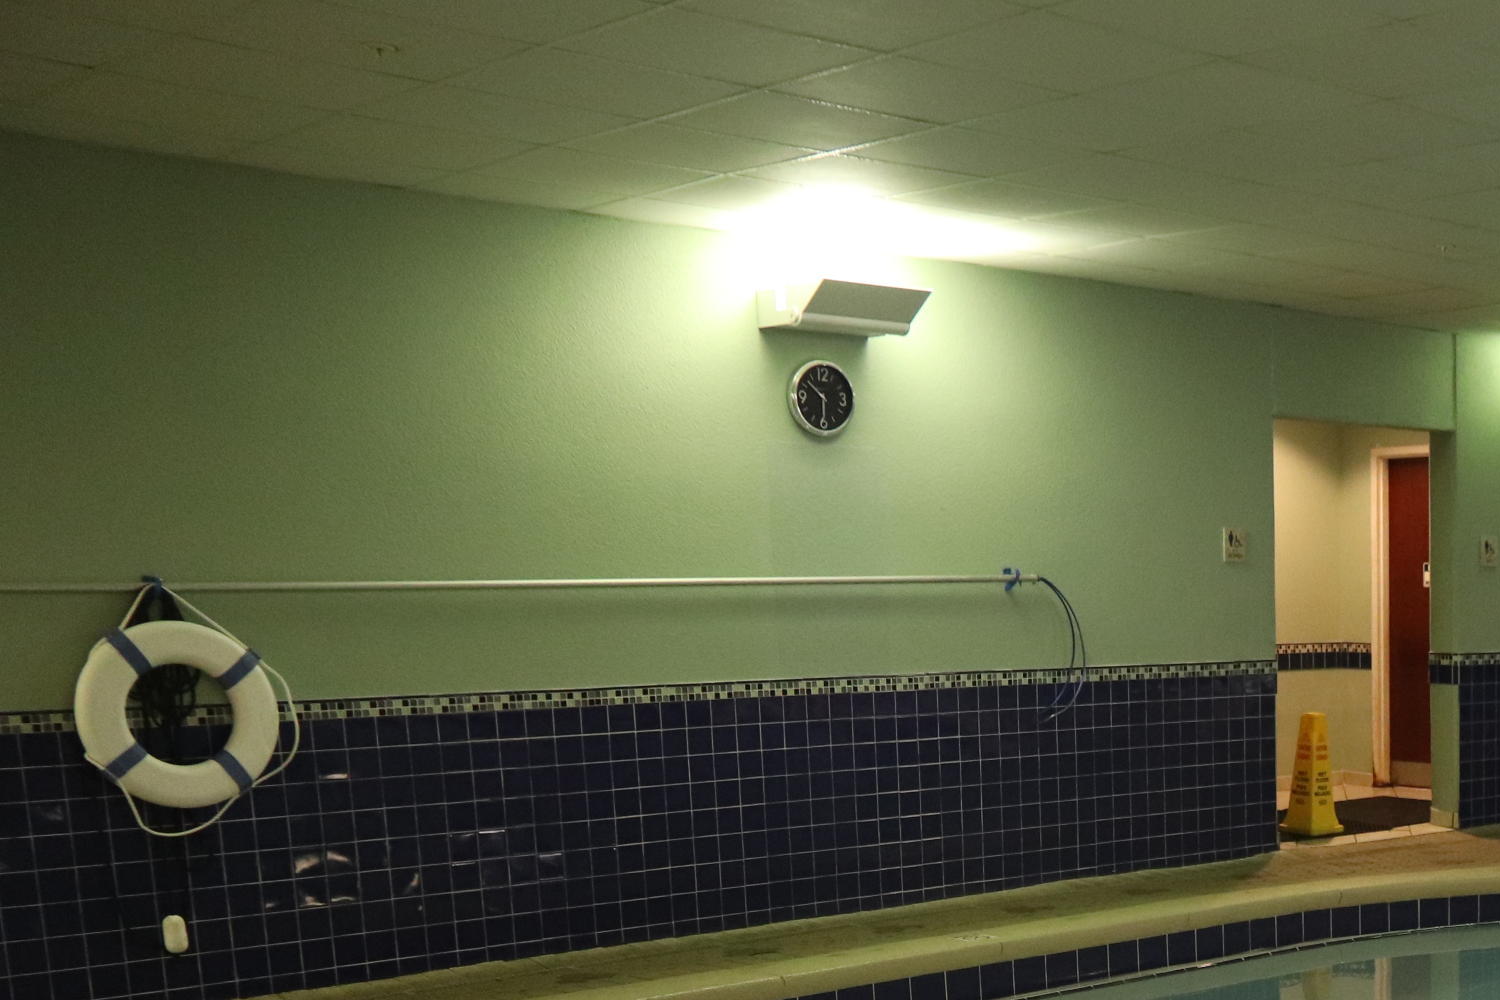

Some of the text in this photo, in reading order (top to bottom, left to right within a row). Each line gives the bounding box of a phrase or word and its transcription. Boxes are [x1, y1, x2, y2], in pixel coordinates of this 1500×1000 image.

[817, 367, 829, 382] 12
[798, 390, 808, 404] 9
[839, 392, 847, 407] 3
